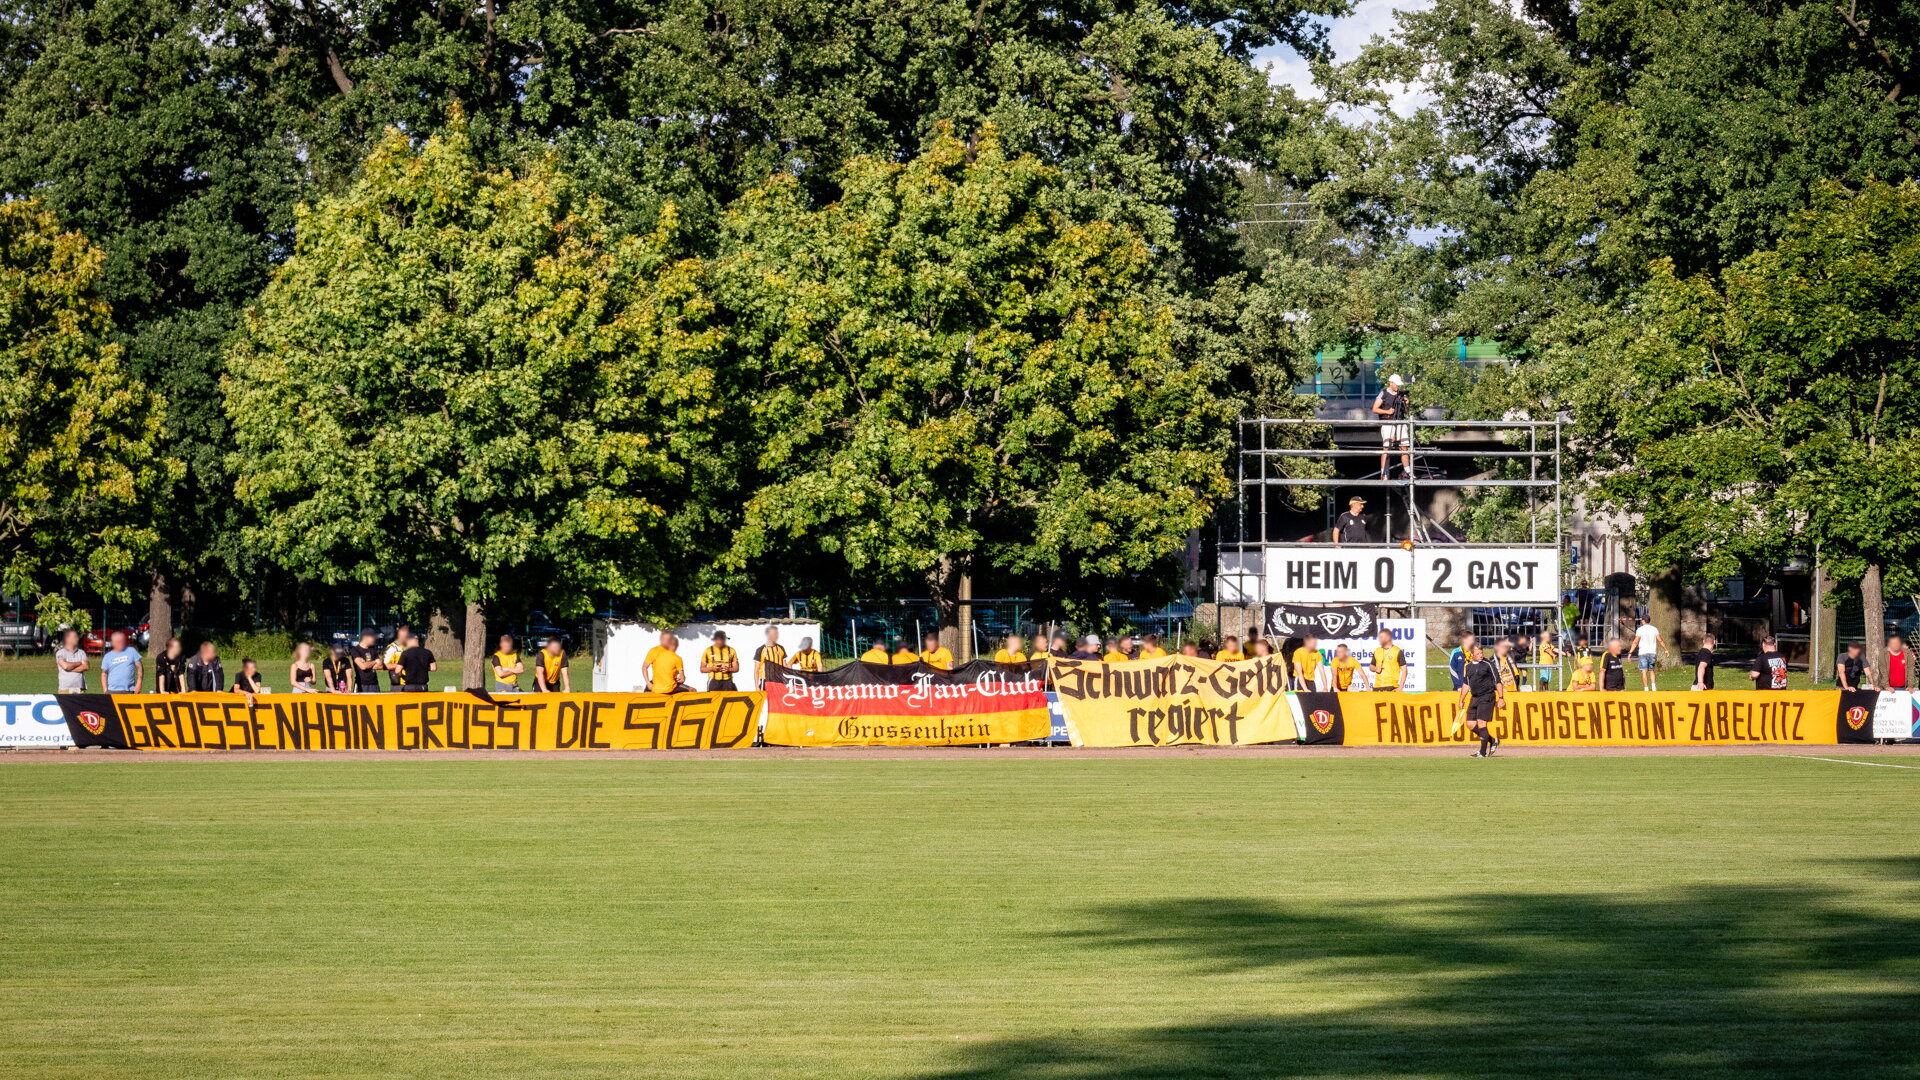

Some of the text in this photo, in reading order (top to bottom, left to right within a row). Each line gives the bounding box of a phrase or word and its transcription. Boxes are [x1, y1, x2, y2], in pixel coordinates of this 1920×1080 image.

[1286, 556, 1395, 594] HEIM 0
[1431, 557, 1539, 594] 2 GAST
[782, 670, 1040, 708] Dynamo-Fan-Club
[1053, 656, 1283, 700] Schwarz-Gelb
[117, 700, 386, 750] GROSSENHAIN
[395, 700, 549, 750] GRÜSST
[555, 700, 616, 750] DIE
[838, 716, 990, 745] Grossenhain
[1127, 699, 1244, 745] regiert
[1495, 700, 1805, 742] SACHSENFRONT-ZABELTITZ
